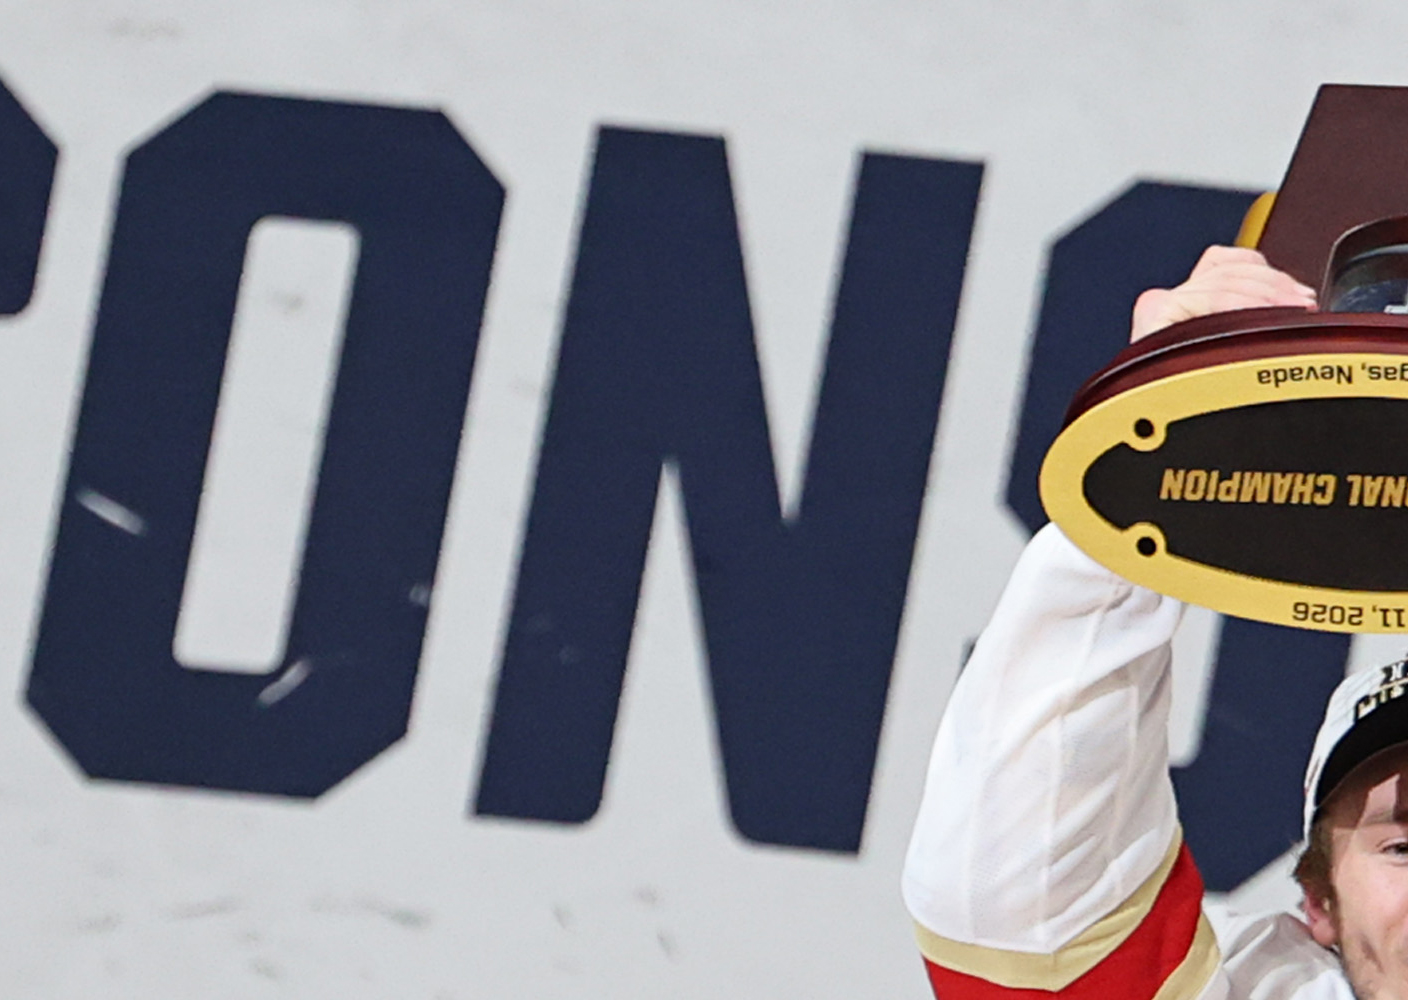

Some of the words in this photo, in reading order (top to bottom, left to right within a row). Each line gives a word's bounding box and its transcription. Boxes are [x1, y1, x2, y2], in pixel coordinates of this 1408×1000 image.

[1257, 365, 1353, 388] Nevada
[1159, 468, 1337, 506] CHAMPION
[1293, 602, 1363, 626] 2026
[1372, 605, 1405, 628] 11,
